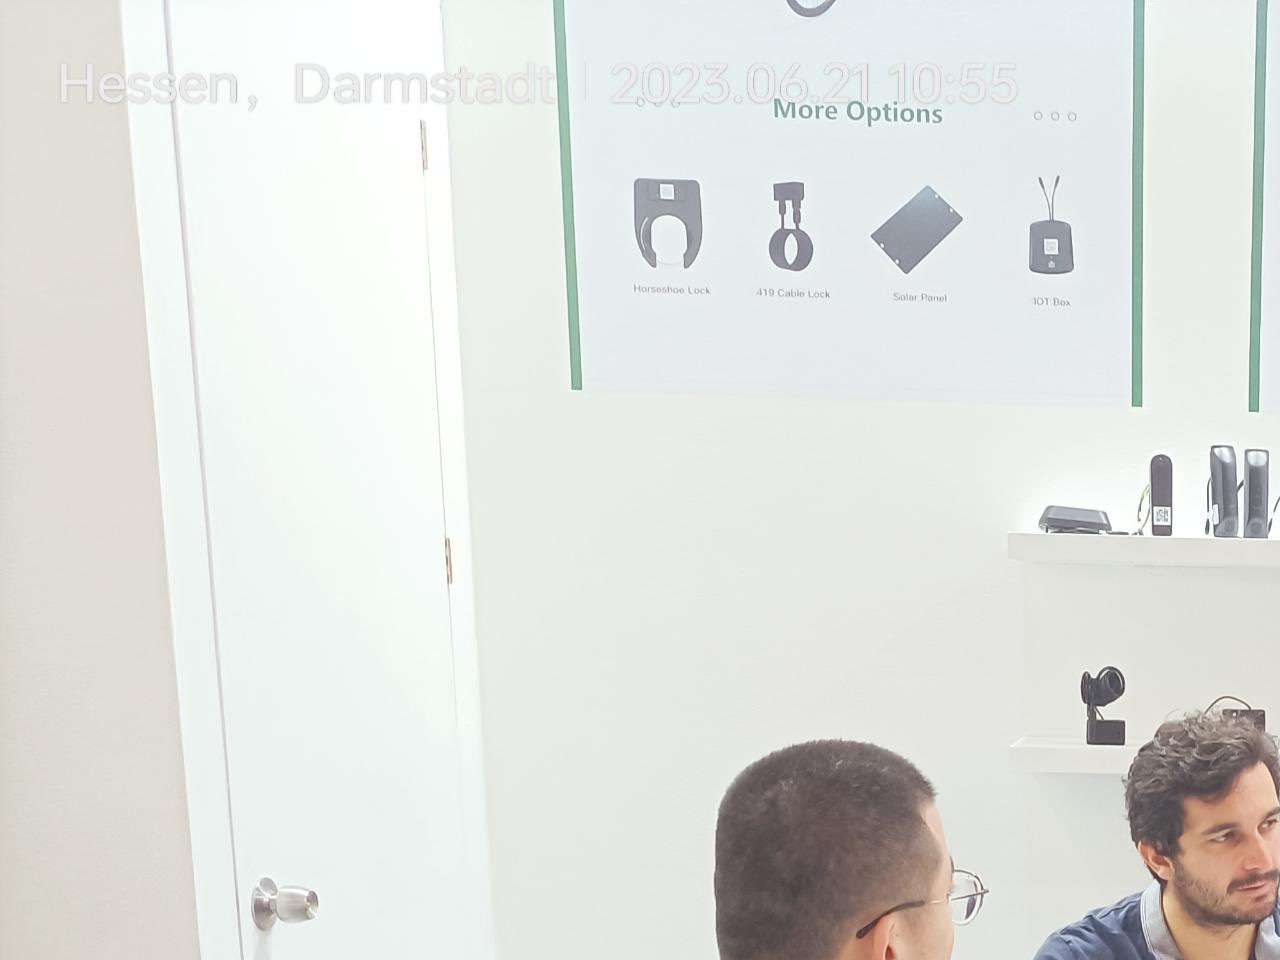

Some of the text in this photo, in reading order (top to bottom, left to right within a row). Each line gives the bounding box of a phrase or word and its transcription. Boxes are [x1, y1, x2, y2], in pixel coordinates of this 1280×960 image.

[773, 98, 944, 127] More Options
[633, 284, 711, 295] Horseshoe Lock
[777, 288, 805, 298] Cable
[807, 288, 831, 299] Lock
[892, 292, 948, 303] Solar Panel
[1032, 296, 1071, 307] IOT Box
